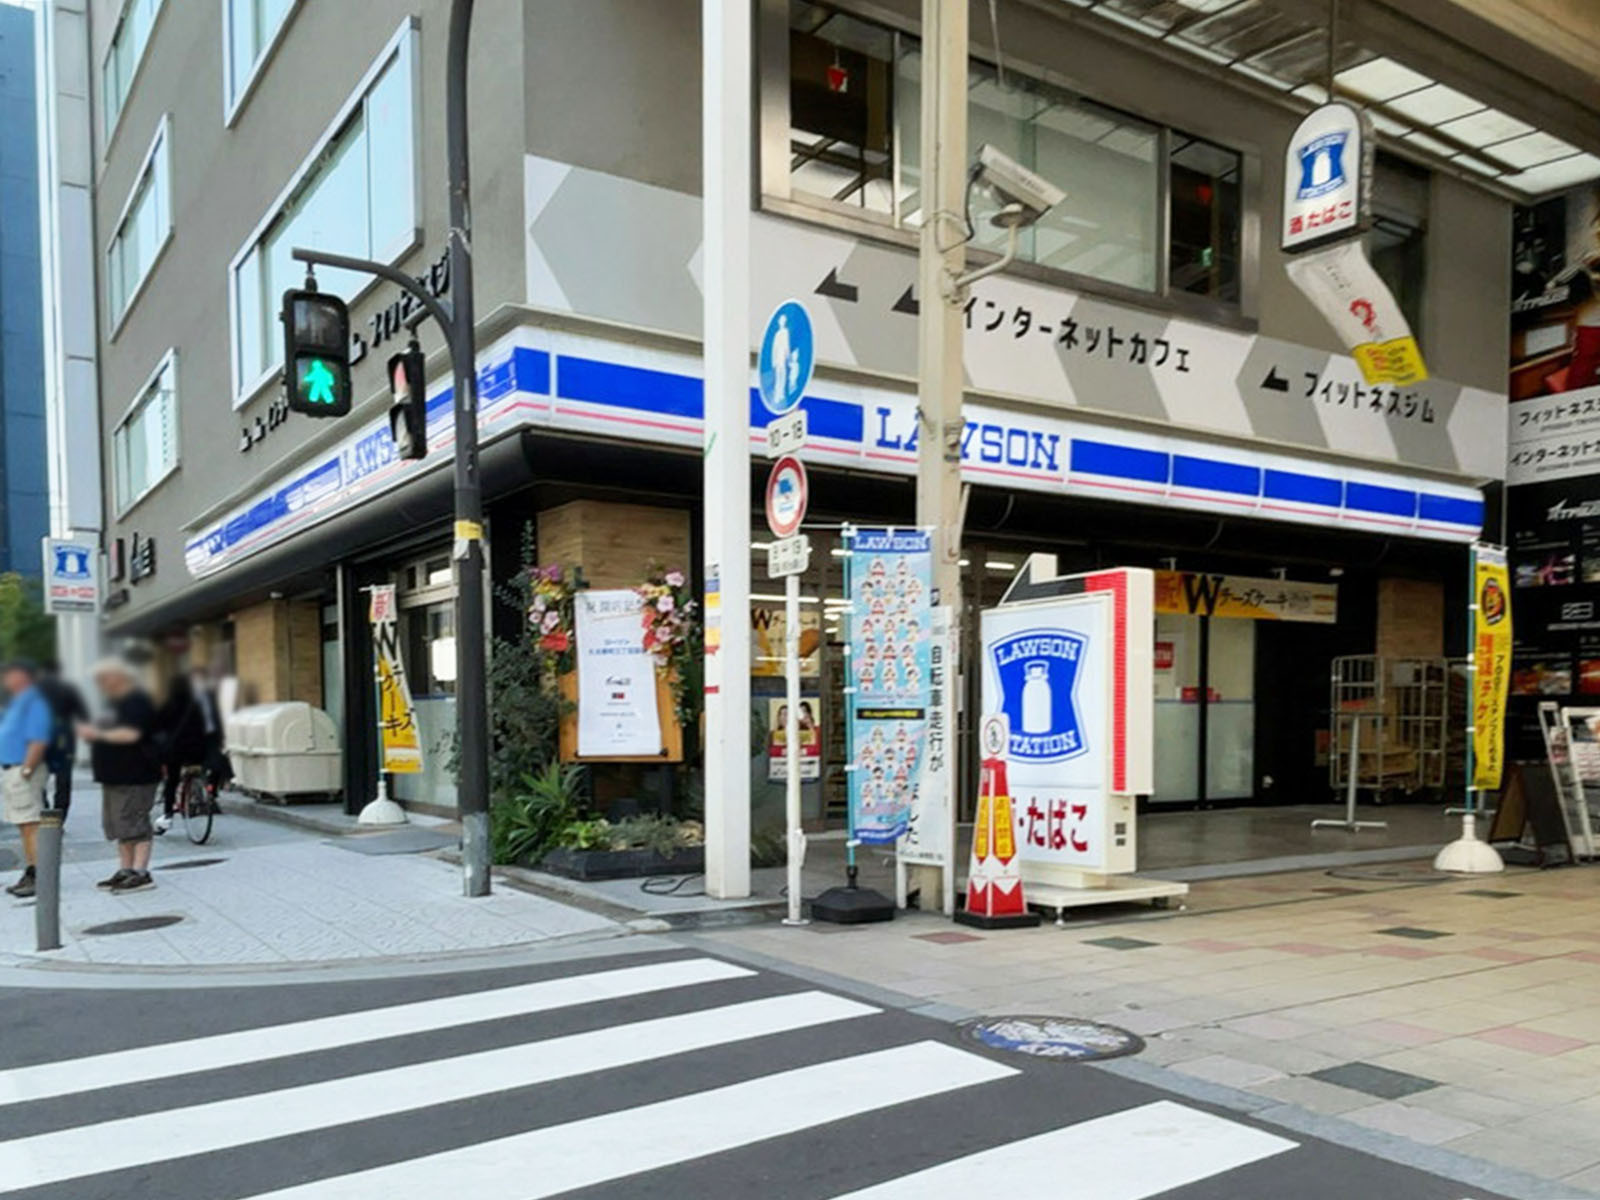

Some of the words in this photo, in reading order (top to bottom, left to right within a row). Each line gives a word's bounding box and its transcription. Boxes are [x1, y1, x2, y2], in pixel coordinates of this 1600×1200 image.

[963, 297, 1190, 372] インターネットカフェ
[1304, 372, 1434, 423] フィットネスジム
[853, 536, 928, 550] LAWSON
[997, 637, 1079, 666] LAWSON
[1009, 729, 1079, 755] TATION
[1011, 796, 1089, 852] ・たばこ
